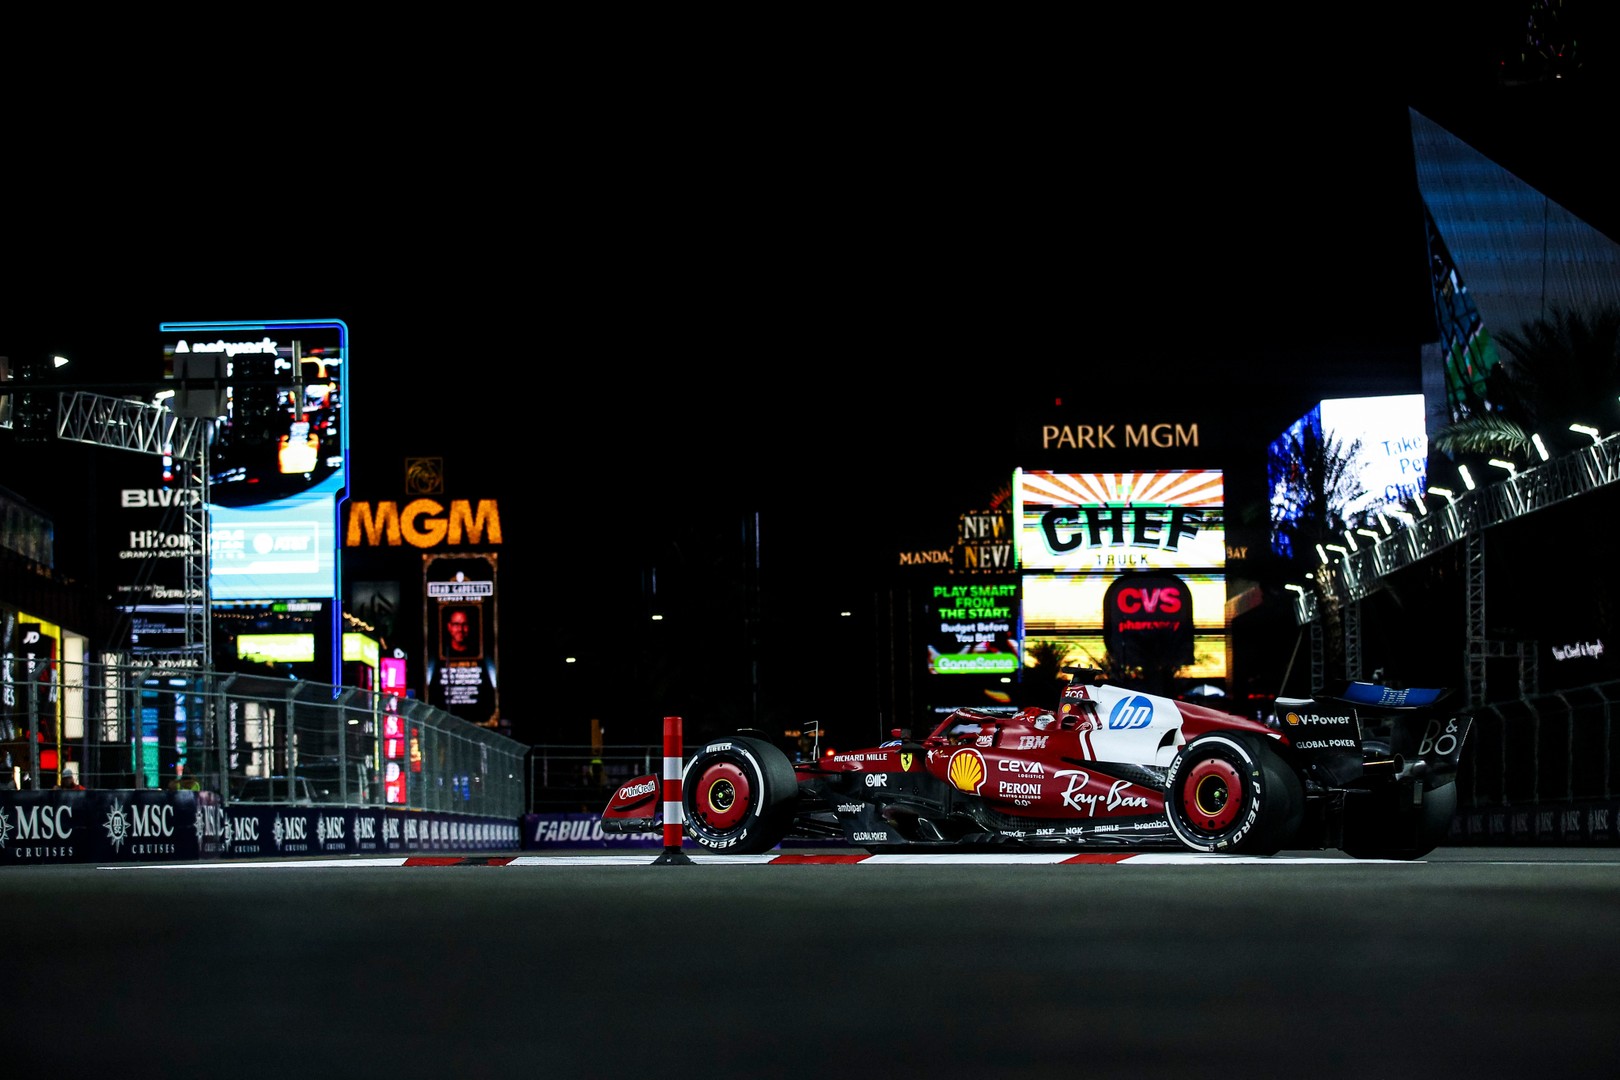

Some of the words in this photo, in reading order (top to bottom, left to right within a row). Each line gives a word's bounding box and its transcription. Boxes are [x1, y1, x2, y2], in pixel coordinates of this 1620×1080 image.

[193, 337, 278, 357] network
[1042, 424, 1115, 449] PARK
[1124, 423, 1199, 448] MGM
[1381, 436, 1422, 456] Take
[121, 488, 200, 508] BLVD
[346, 497, 503, 549] MGM
[964, 516, 1006, 539] NEW
[1040, 502, 1205, 556] CHEF
[964, 545, 1010, 569] NEW
[1096, 553, 1148, 567] TRUCK
[933, 586, 968, 598] PLAY
[969, 584, 1017, 597] SMART
[955, 597, 995, 609] FROM
[1117, 587, 1181, 613] CVS
[938, 608, 966, 619] THE
[968, 607, 1012, 619] START.
[941, 623, 976, 635] Budget
[976, 622, 1010, 633] Before
[22, 631, 40, 644] JD
[955, 634, 974, 643] You
[938, 657, 1014, 670] GameSense
[1109, 696, 1154, 729] hp
[1298, 713, 1350, 726] V-Power
[1017, 735, 1050, 750] IBM
[1296, 739, 1329, 750] GLOBAL
[1329, 739, 1356, 748] POKER
[833, 753, 865, 763] RICHARD
[866, 752, 888, 761] MILLE
[627, 780, 656, 798] UniCredit
[999, 781, 1042, 795] PERONI
[1252, 780, 1261, 795] P
[15, 805, 73, 840] MSC
[131, 803, 175, 837] MSC
[326, 816, 345, 839] MSC
[1134, 820, 1168, 831] brembo
[1232, 796, 1260, 844] ZERO
[234, 816, 260, 841] MSC
[284, 816, 308, 840] MSC
[361, 817, 376, 839] MSC
[534, 820, 625, 842] FABULO
[740, 828, 748, 841] P
[1035, 827, 1056, 836] SKF
[1065, 826, 1083, 835] NGK
[1094, 824, 1120, 833] MAHLE
[131, 843, 176, 855] CRUISES
[698, 836, 737, 849] ZERO
[16, 846, 74, 858] CRUISES
